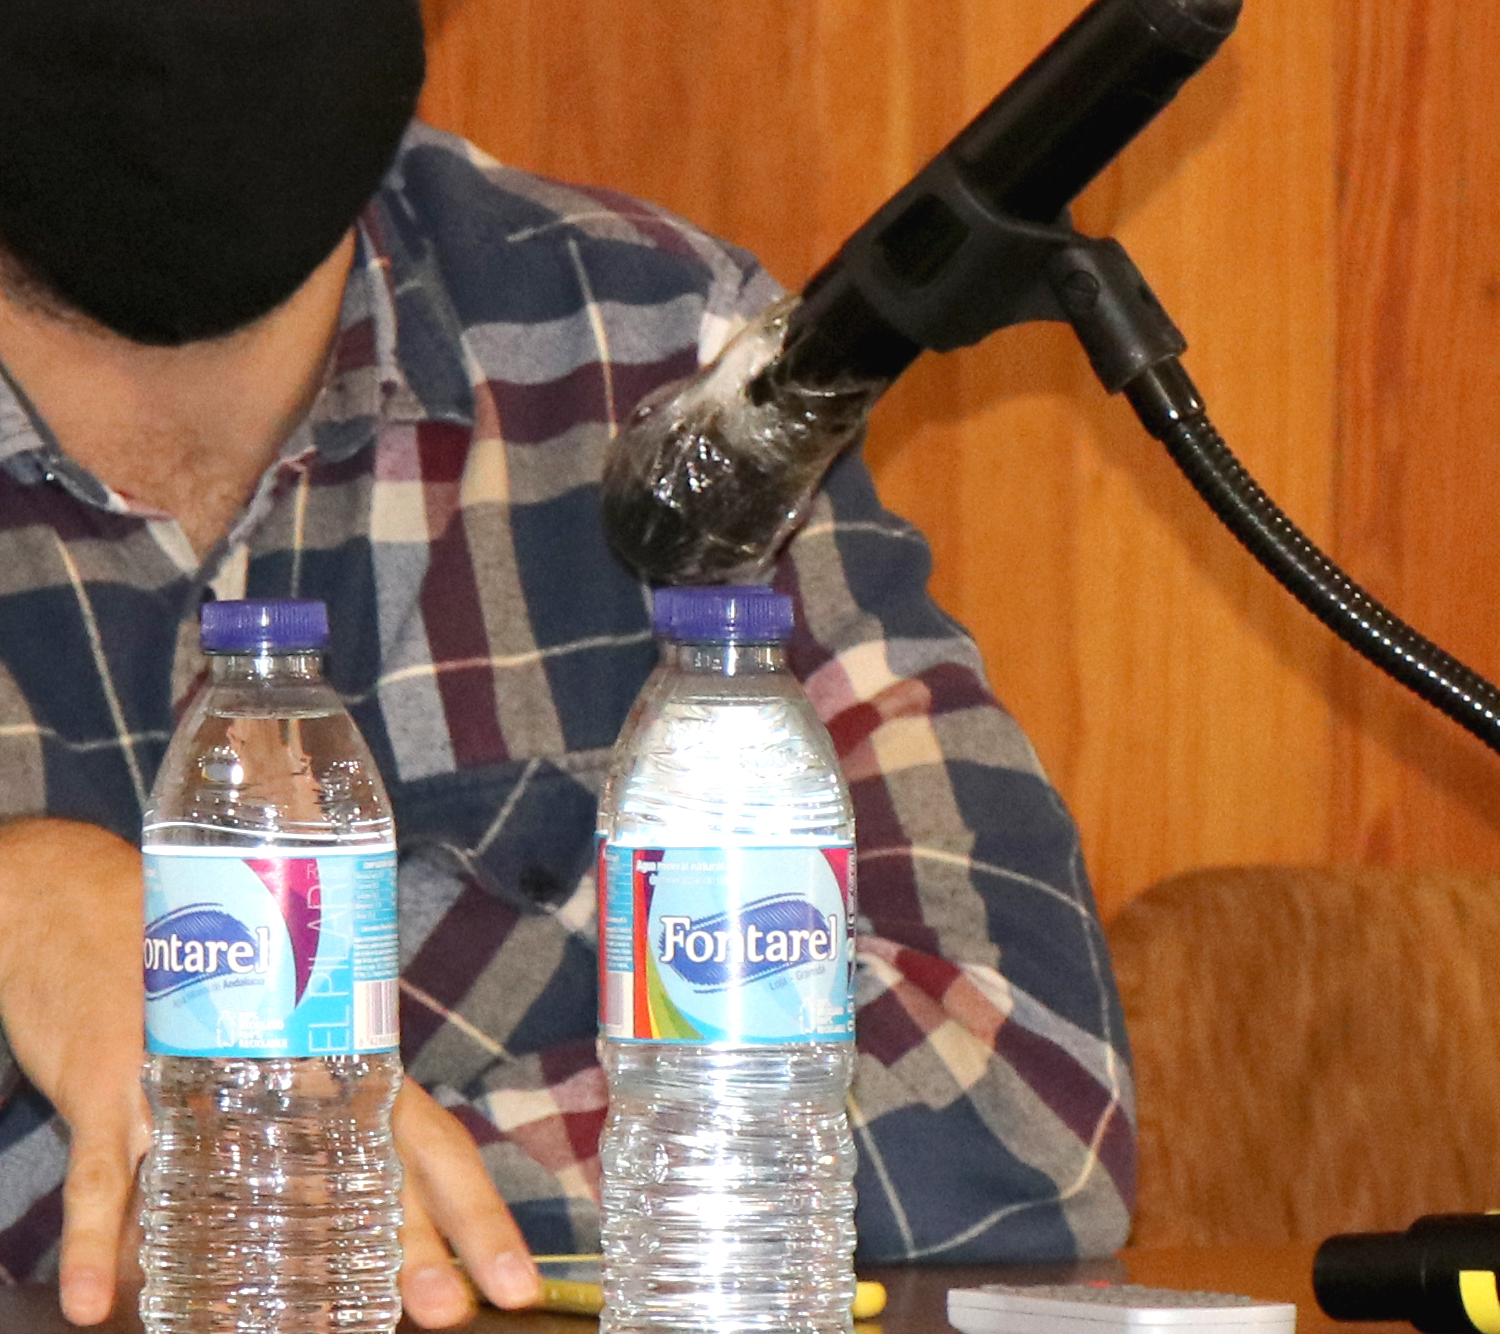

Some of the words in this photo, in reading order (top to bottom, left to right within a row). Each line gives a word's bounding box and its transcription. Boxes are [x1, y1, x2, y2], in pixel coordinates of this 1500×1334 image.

[144, 926, 270, 974] ontarel
[306, 882, 350, 997] PILAR
[660, 914, 838, 964] Fontarel
